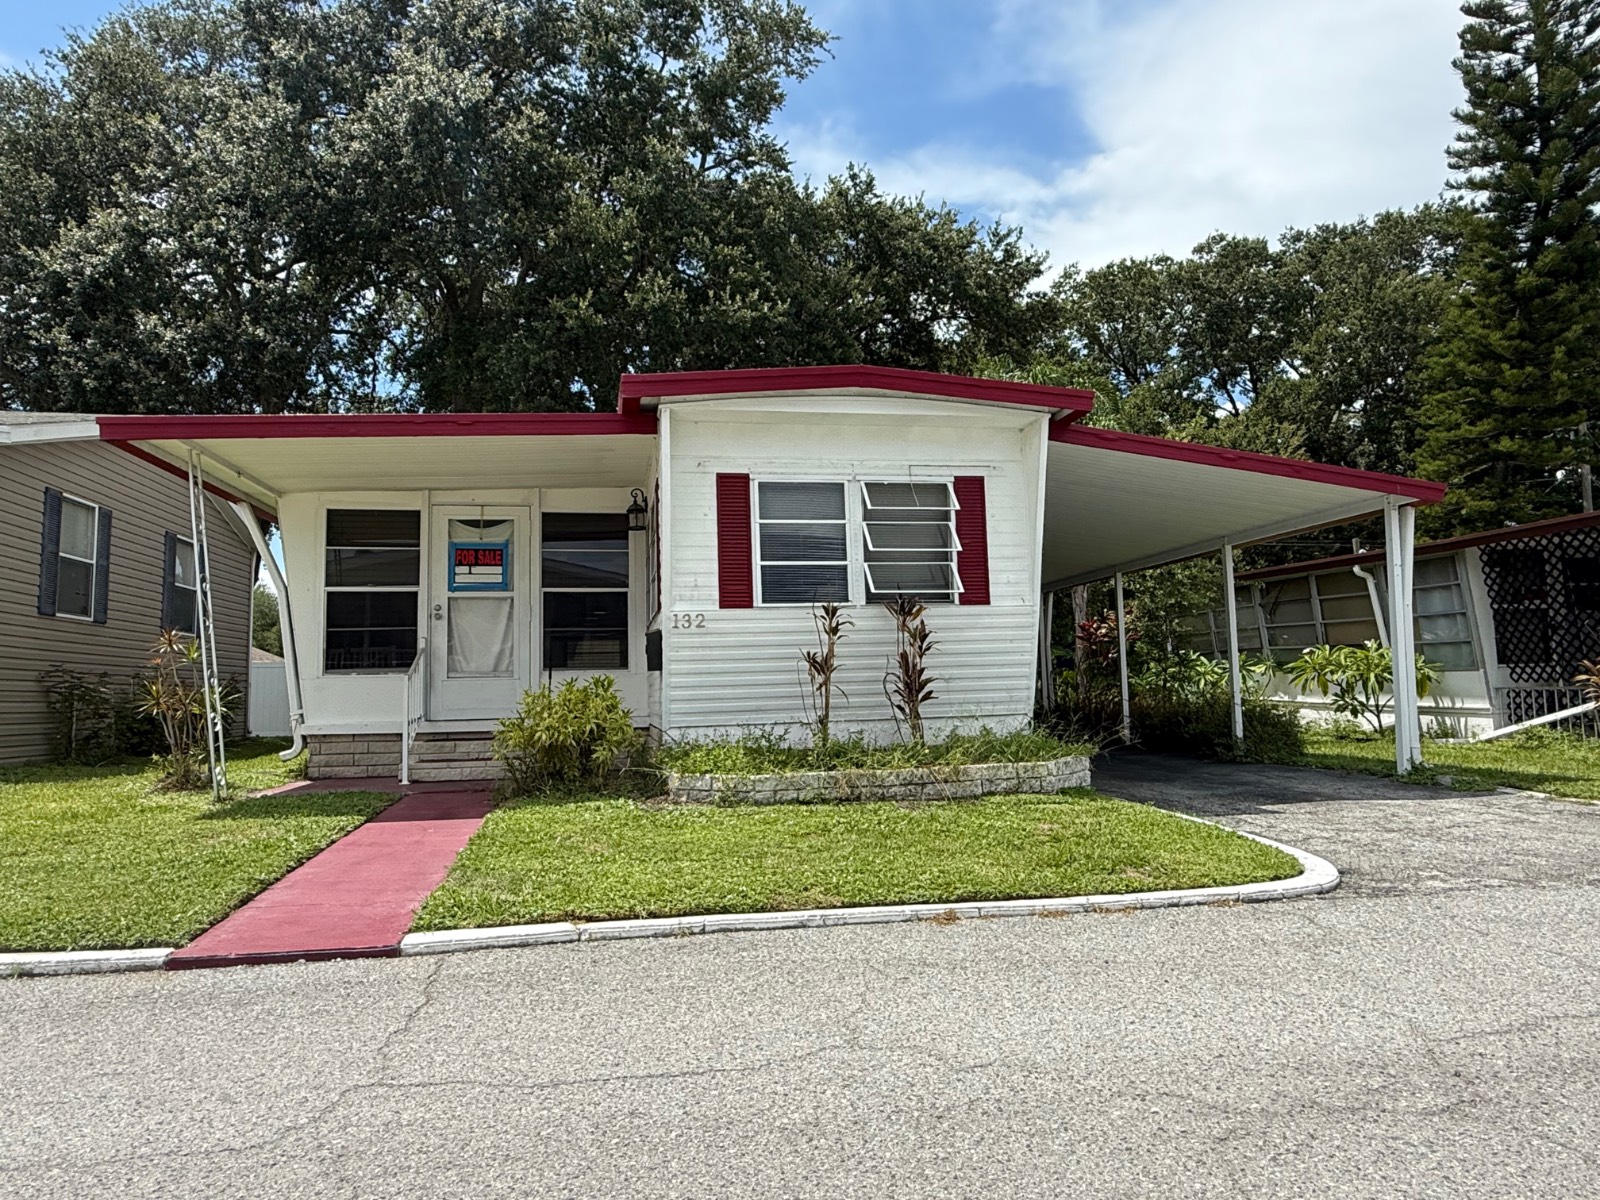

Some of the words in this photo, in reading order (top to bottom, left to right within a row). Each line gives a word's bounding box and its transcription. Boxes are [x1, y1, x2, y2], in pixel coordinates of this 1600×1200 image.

[456, 550, 475, 565] FOR
[478, 550, 502, 565] SALE
[672, 613, 706, 629] 132
